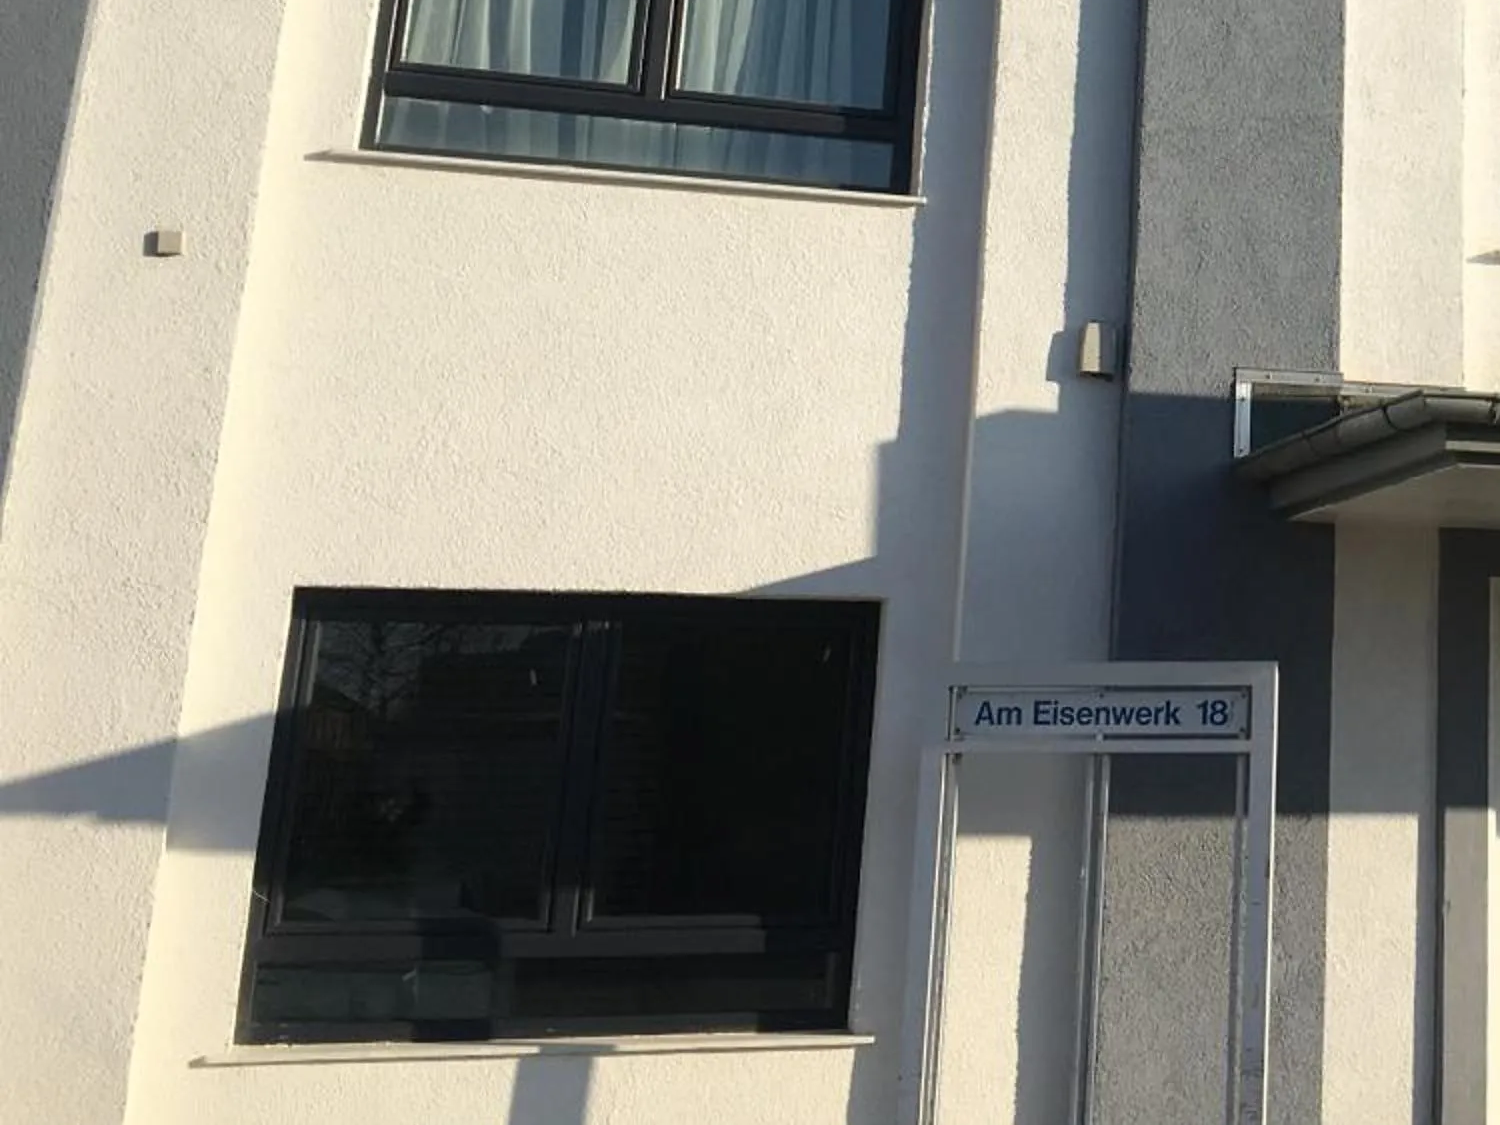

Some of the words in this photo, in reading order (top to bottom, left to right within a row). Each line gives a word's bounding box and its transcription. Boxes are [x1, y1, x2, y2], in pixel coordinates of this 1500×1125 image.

[974, 700, 1023, 726] Am
[1033, 700, 1182, 726] Eisenwerk
[1196, 699, 1229, 726] 18
